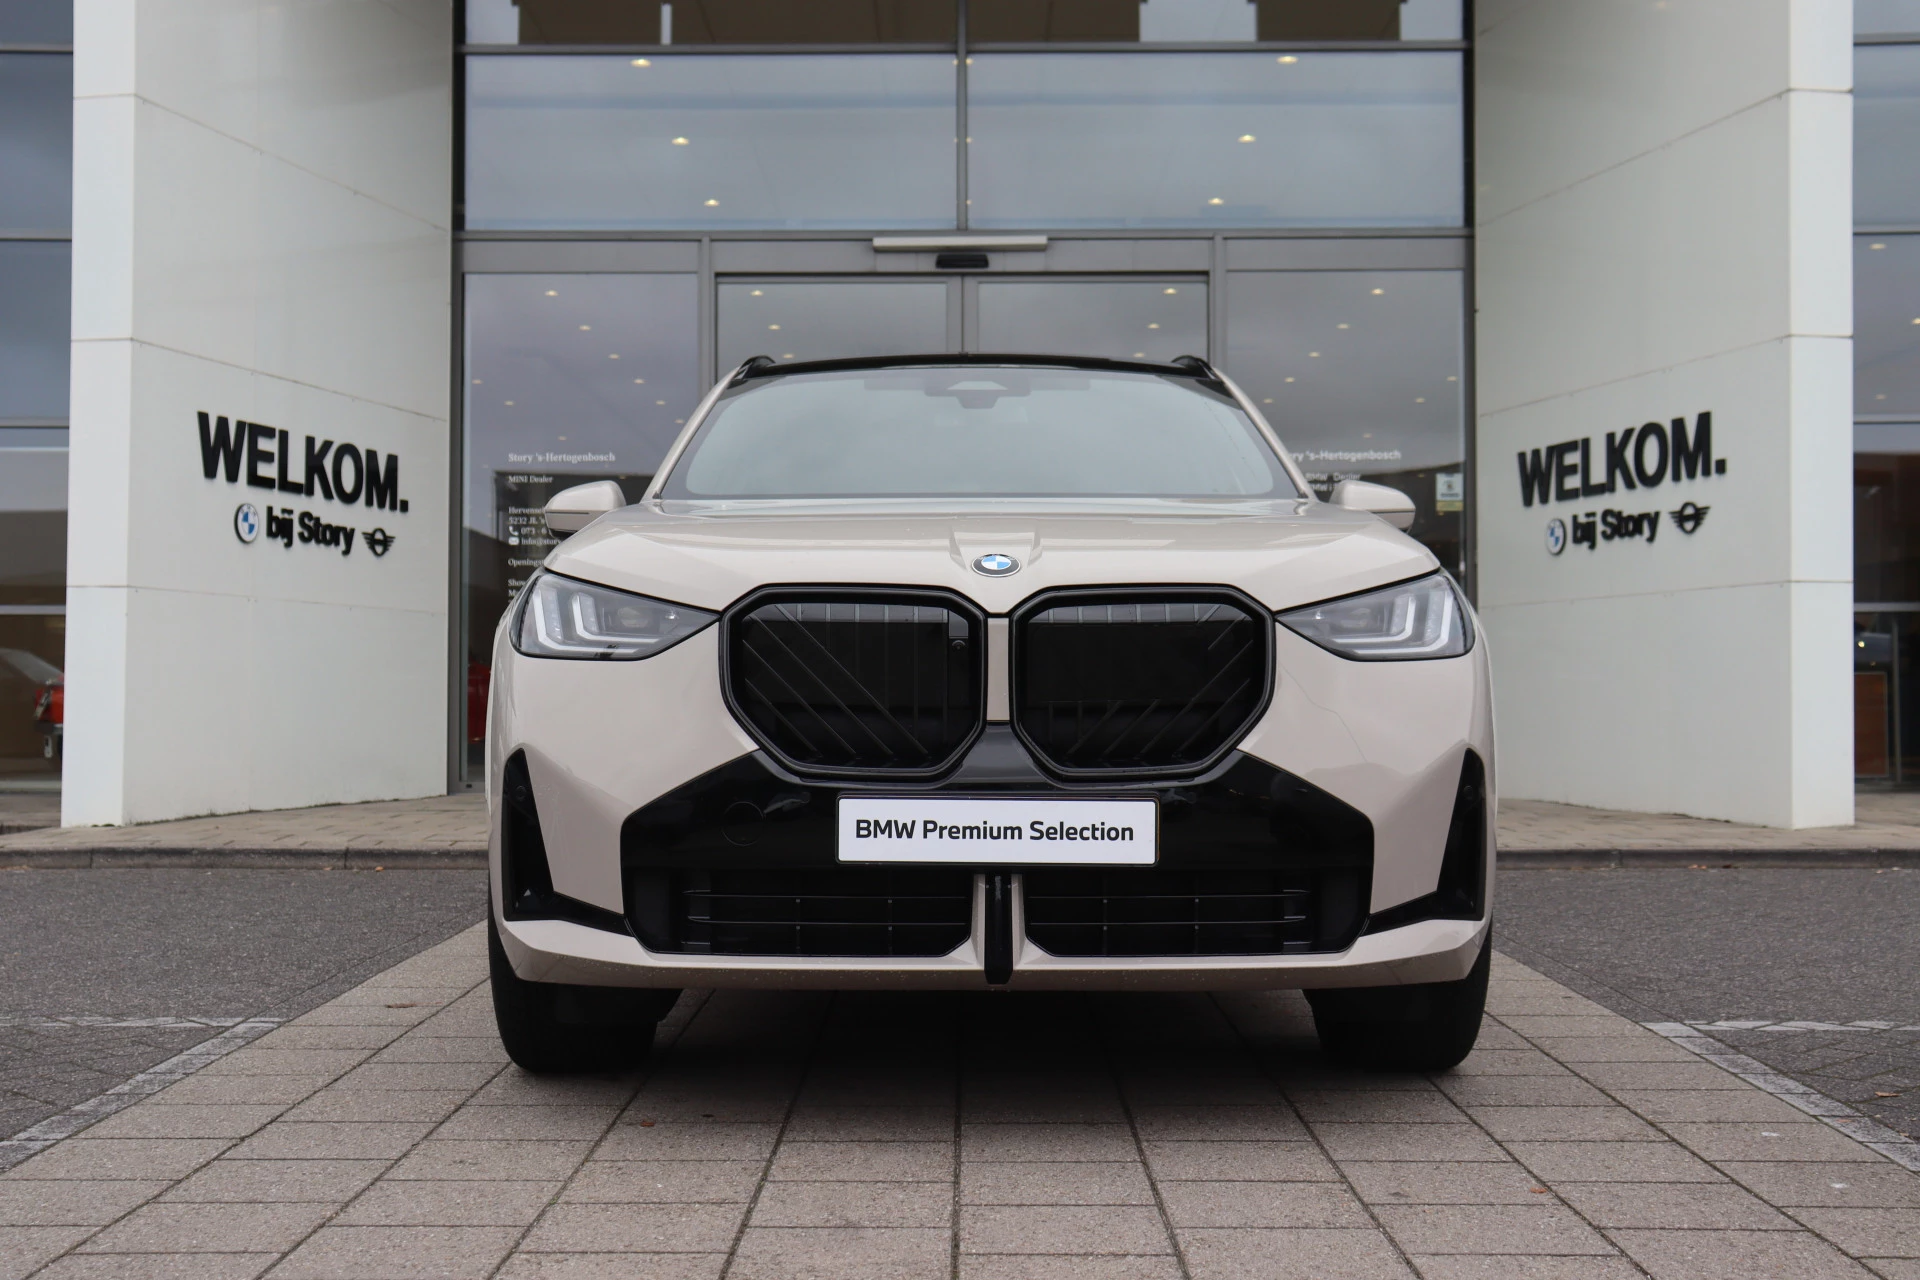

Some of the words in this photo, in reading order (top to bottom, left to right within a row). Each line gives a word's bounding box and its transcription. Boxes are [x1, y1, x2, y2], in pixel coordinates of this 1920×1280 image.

[197, 410, 409, 513] WELKOM.
[508, 453, 533, 464] Story
[536, 452, 616, 464] 's-Hertogenbosch
[1306, 450, 1401, 462] 's-Hertogenbosch
[1517, 411, 1727, 507] WELKOM.
[508, 475, 527, 483] MINI
[529, 475, 553, 483] Dealer
[266, 506, 293, 548] bij
[298, 511, 355, 556] Story
[1572, 512, 1597, 550] bij
[1601, 509, 1660, 543] Story
[855, 819, 916, 839] BMW
[923, 819, 1023, 840] Premium
[1029, 820, 1134, 841] Selection
